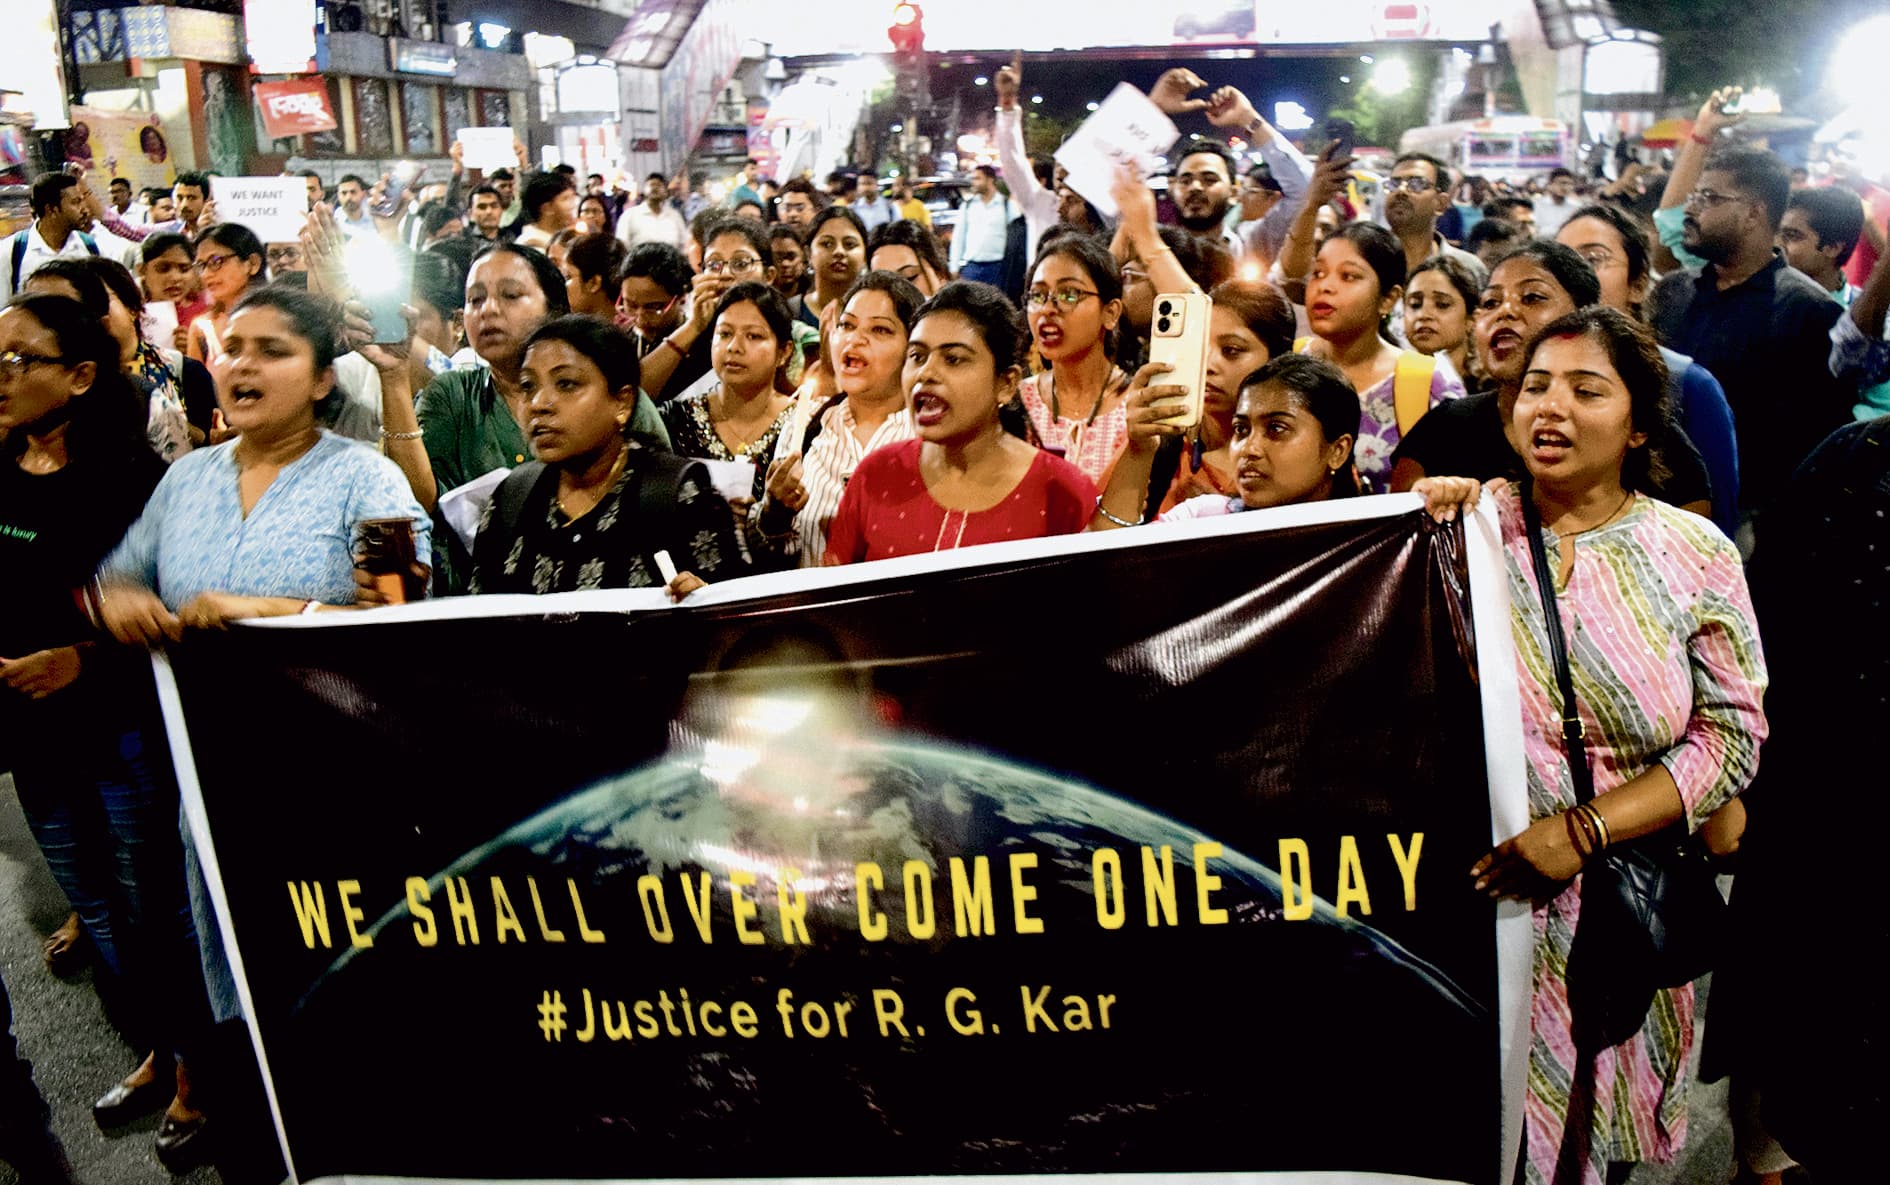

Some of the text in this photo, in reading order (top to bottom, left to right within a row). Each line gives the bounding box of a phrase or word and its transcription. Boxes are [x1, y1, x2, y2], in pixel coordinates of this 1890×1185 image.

[230, 190, 284, 200] WE WANT
[238, 207, 279, 217] JUSTICE
[287, 832, 1425, 950] WE SHALL OVER COME ONE DAY
[537, 984, 1117, 1043] #Justice for R. G. Kar
